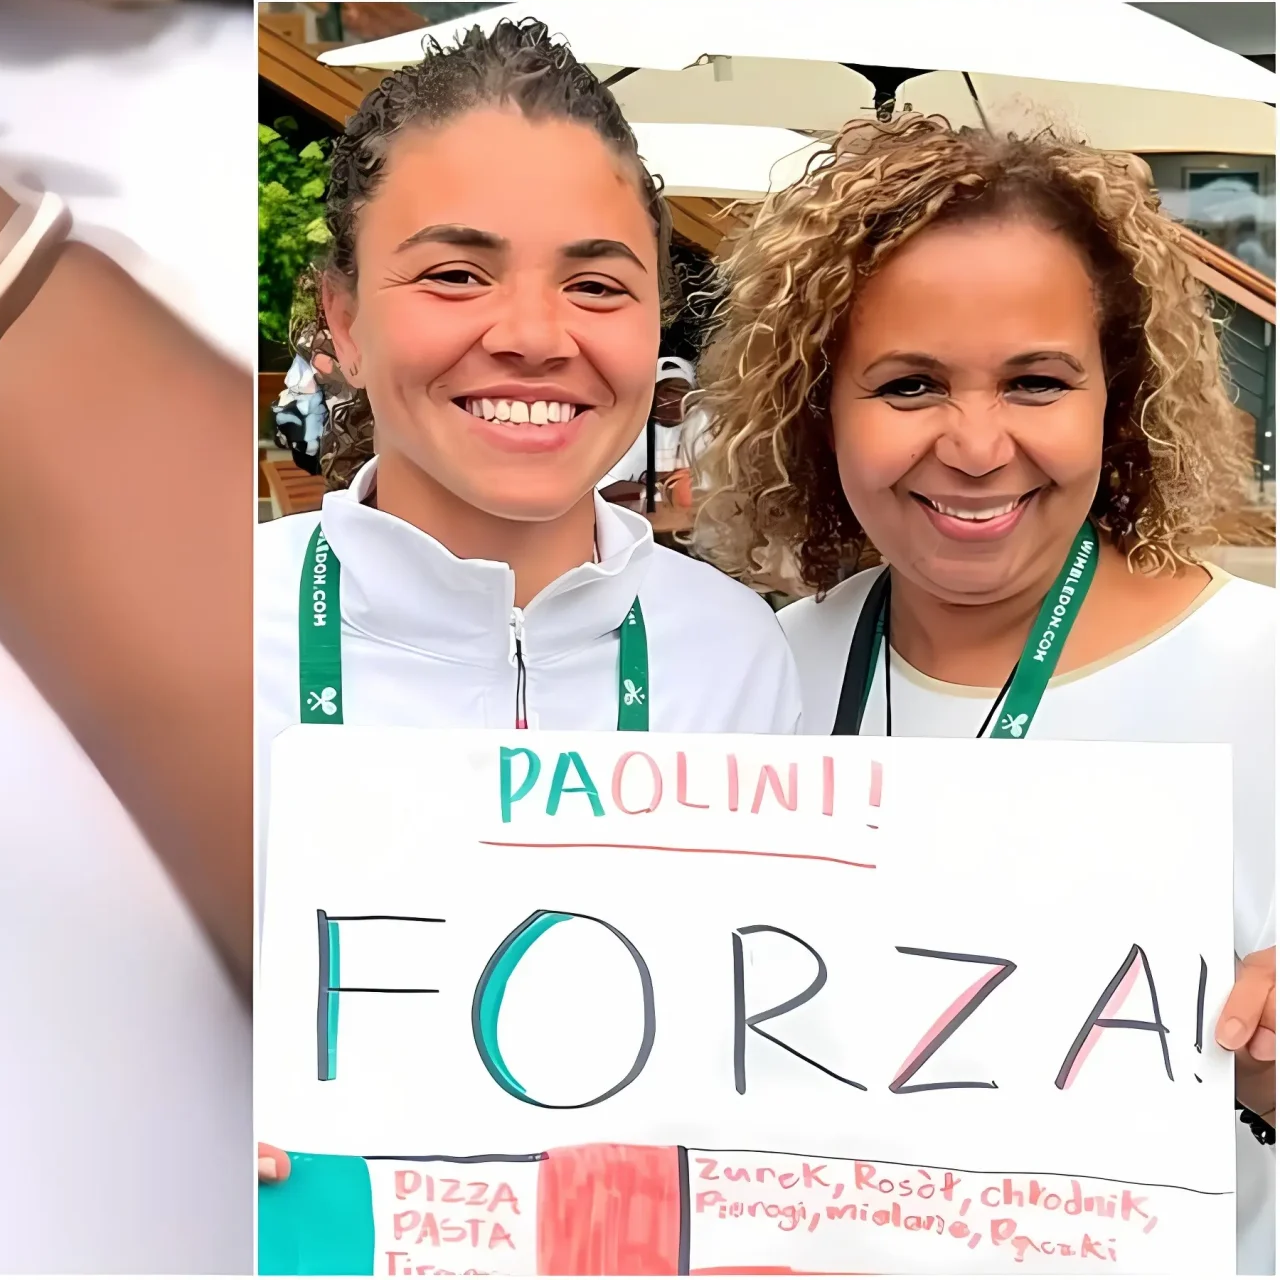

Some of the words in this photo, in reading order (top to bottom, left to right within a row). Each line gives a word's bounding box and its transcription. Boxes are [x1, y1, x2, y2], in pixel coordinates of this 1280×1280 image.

[1023, 530, 1095, 663] WIMBLEDON.COM
[499, 746, 883, 829] PAOLINI!
[316, 908, 1209, 1110] FORZA!
[393, 1209, 516, 1251] PASTA
[394, 1169, 521, 1215] PIZZA
